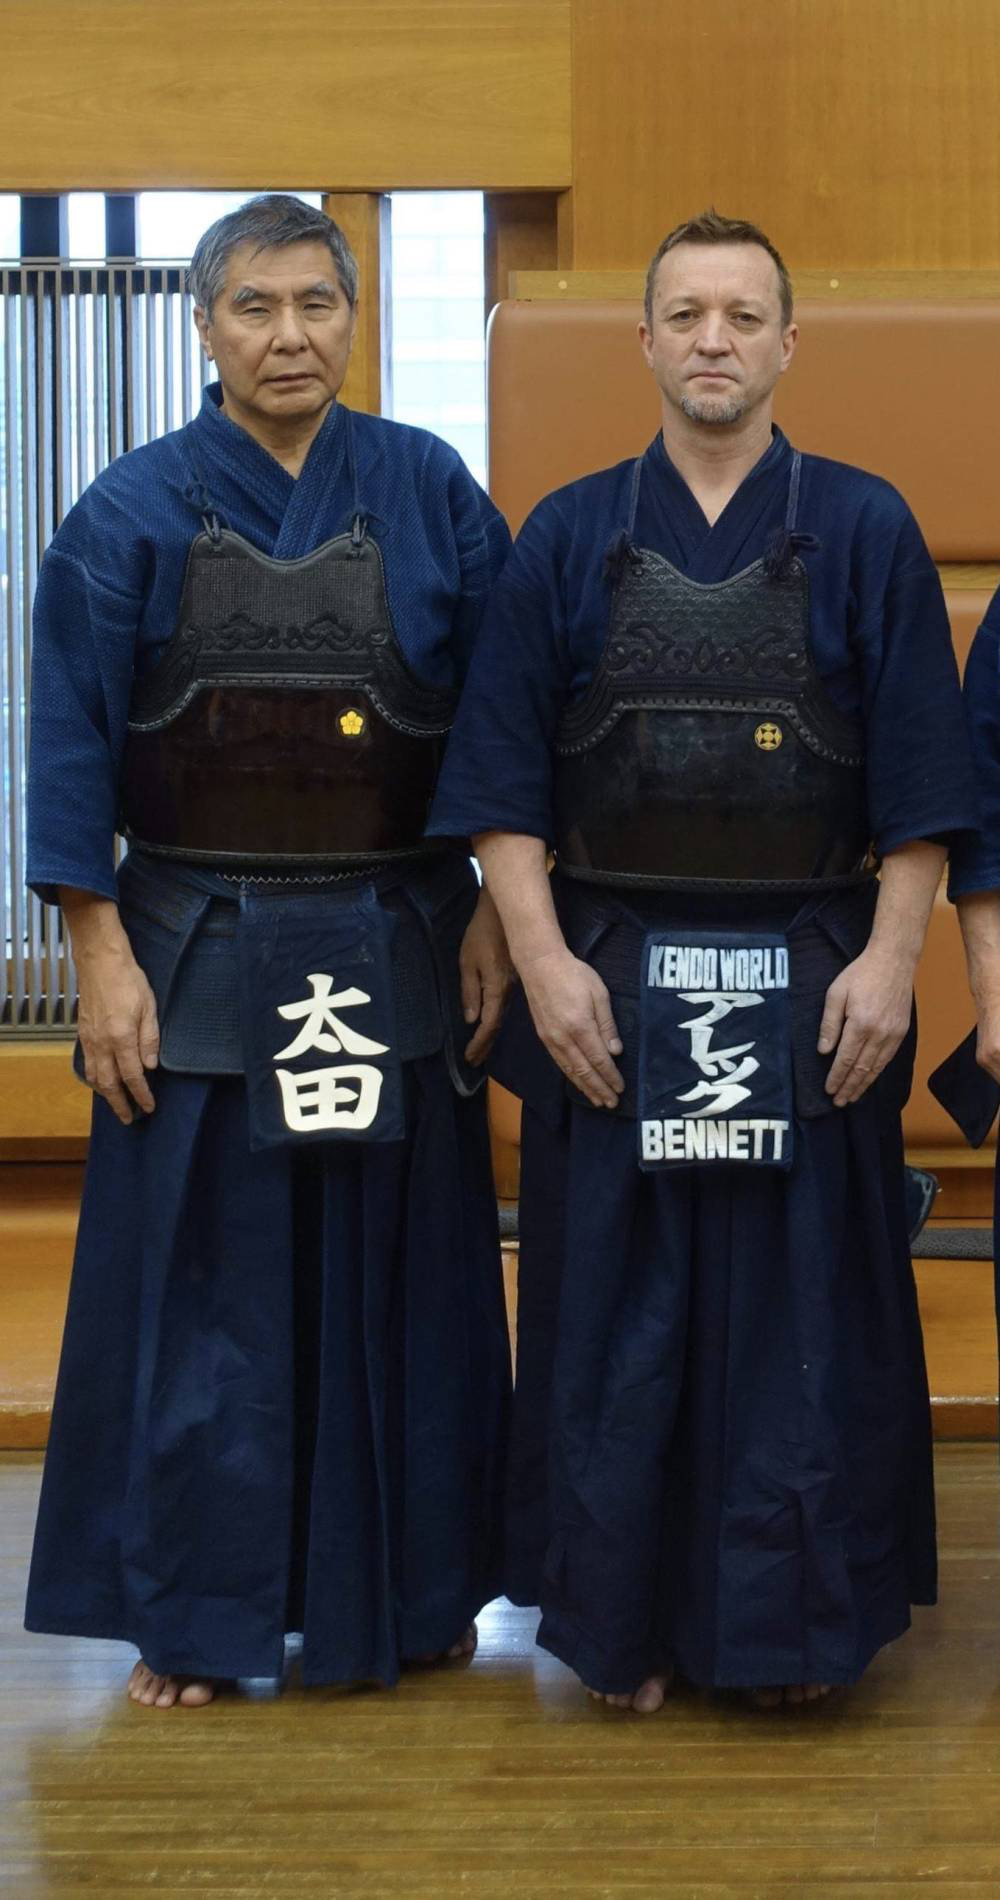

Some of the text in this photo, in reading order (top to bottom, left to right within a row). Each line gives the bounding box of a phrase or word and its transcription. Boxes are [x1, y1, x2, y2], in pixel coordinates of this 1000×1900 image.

[648, 945, 789, 991] KENDO WORLD
[273, 973, 390, 1132] 太田
[676, 991, 765, 1118] アレック
[641, 1119, 789, 1161] BENNETT
